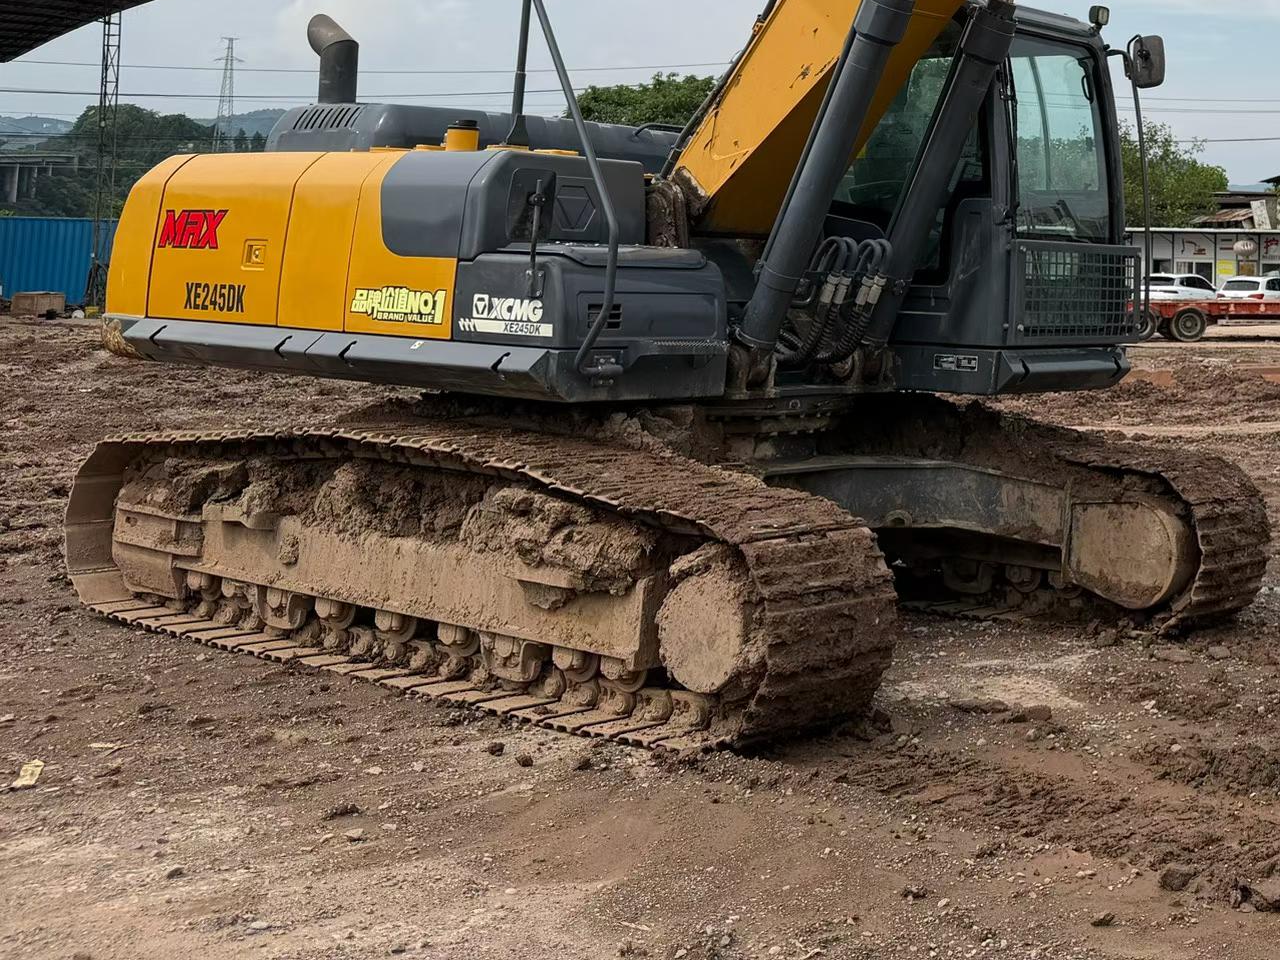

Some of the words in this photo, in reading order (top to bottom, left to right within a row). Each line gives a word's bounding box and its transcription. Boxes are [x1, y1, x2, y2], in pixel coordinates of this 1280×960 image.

[157, 209, 229, 250] MAX
[184, 282, 246, 313] XE245DK
[488, 297, 544, 323] XCMG
[377, 311, 404, 322] BRAND
[406, 313, 434, 324] VALUE
[503, 322, 542, 335] XE245DK
